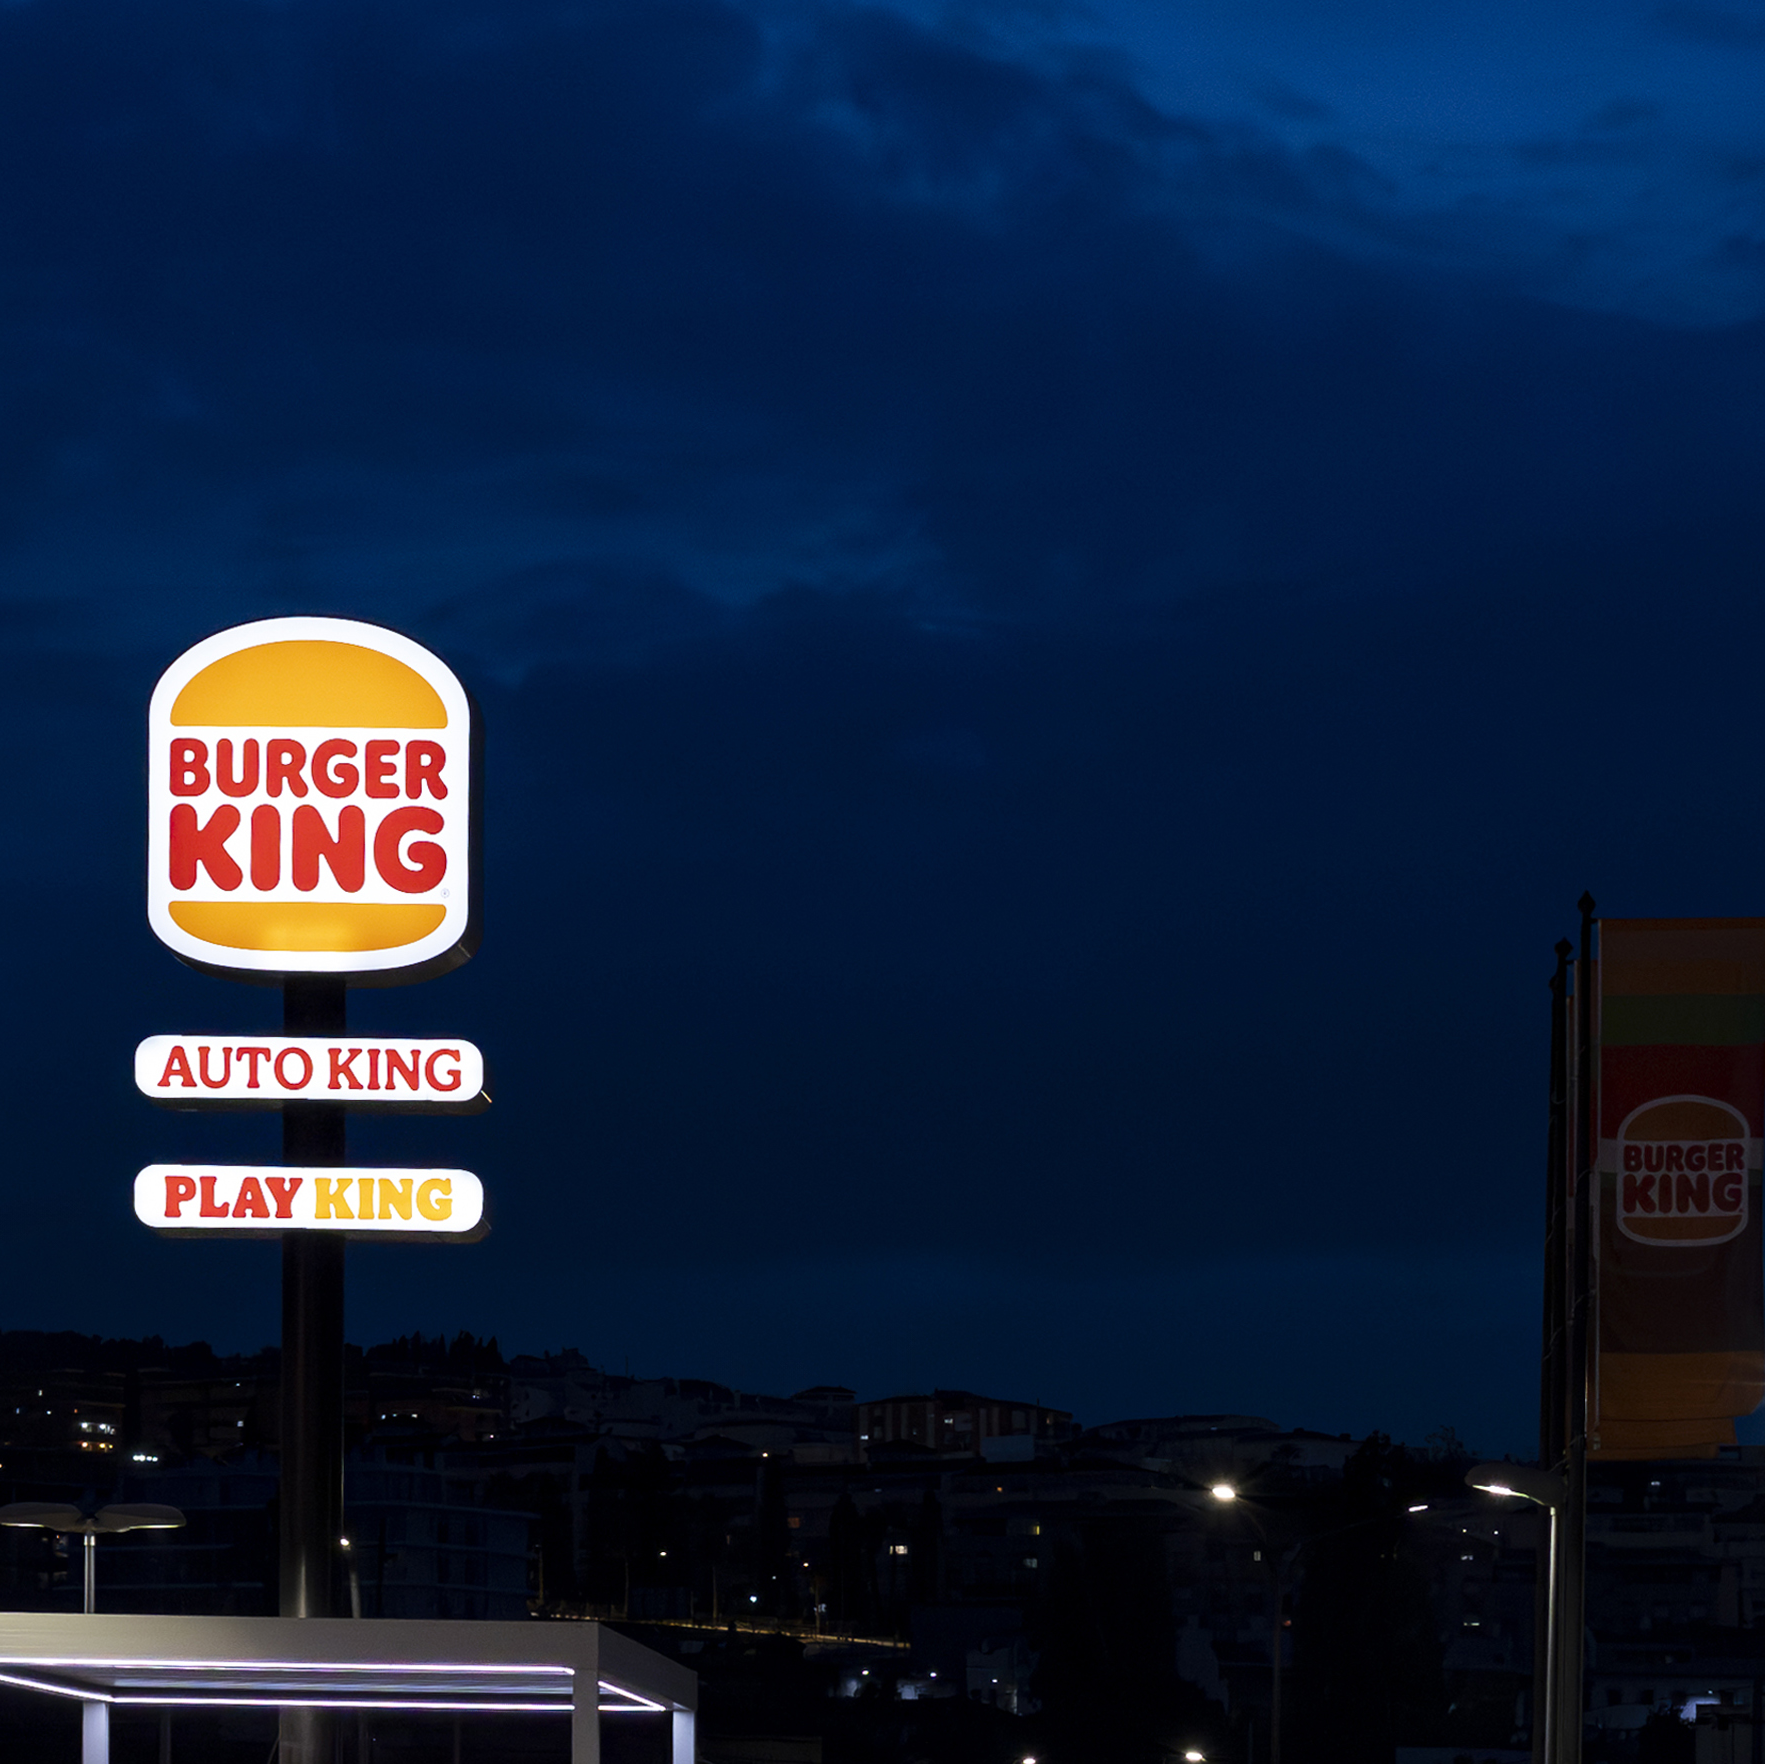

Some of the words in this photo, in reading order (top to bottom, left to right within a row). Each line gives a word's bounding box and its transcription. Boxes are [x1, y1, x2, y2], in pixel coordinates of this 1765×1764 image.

[168, 737, 448, 800] BURGER
[168, 803, 448, 894] KING
[157, 1046, 313, 1091] AUTO
[327, 1048, 463, 1092] KING
[1623, 1143, 1745, 1173] BURGER
[164, 1175, 303, 1219] PLAY
[315, 1177, 453, 1221] KING
[1622, 1173, 1743, 1214] KING
